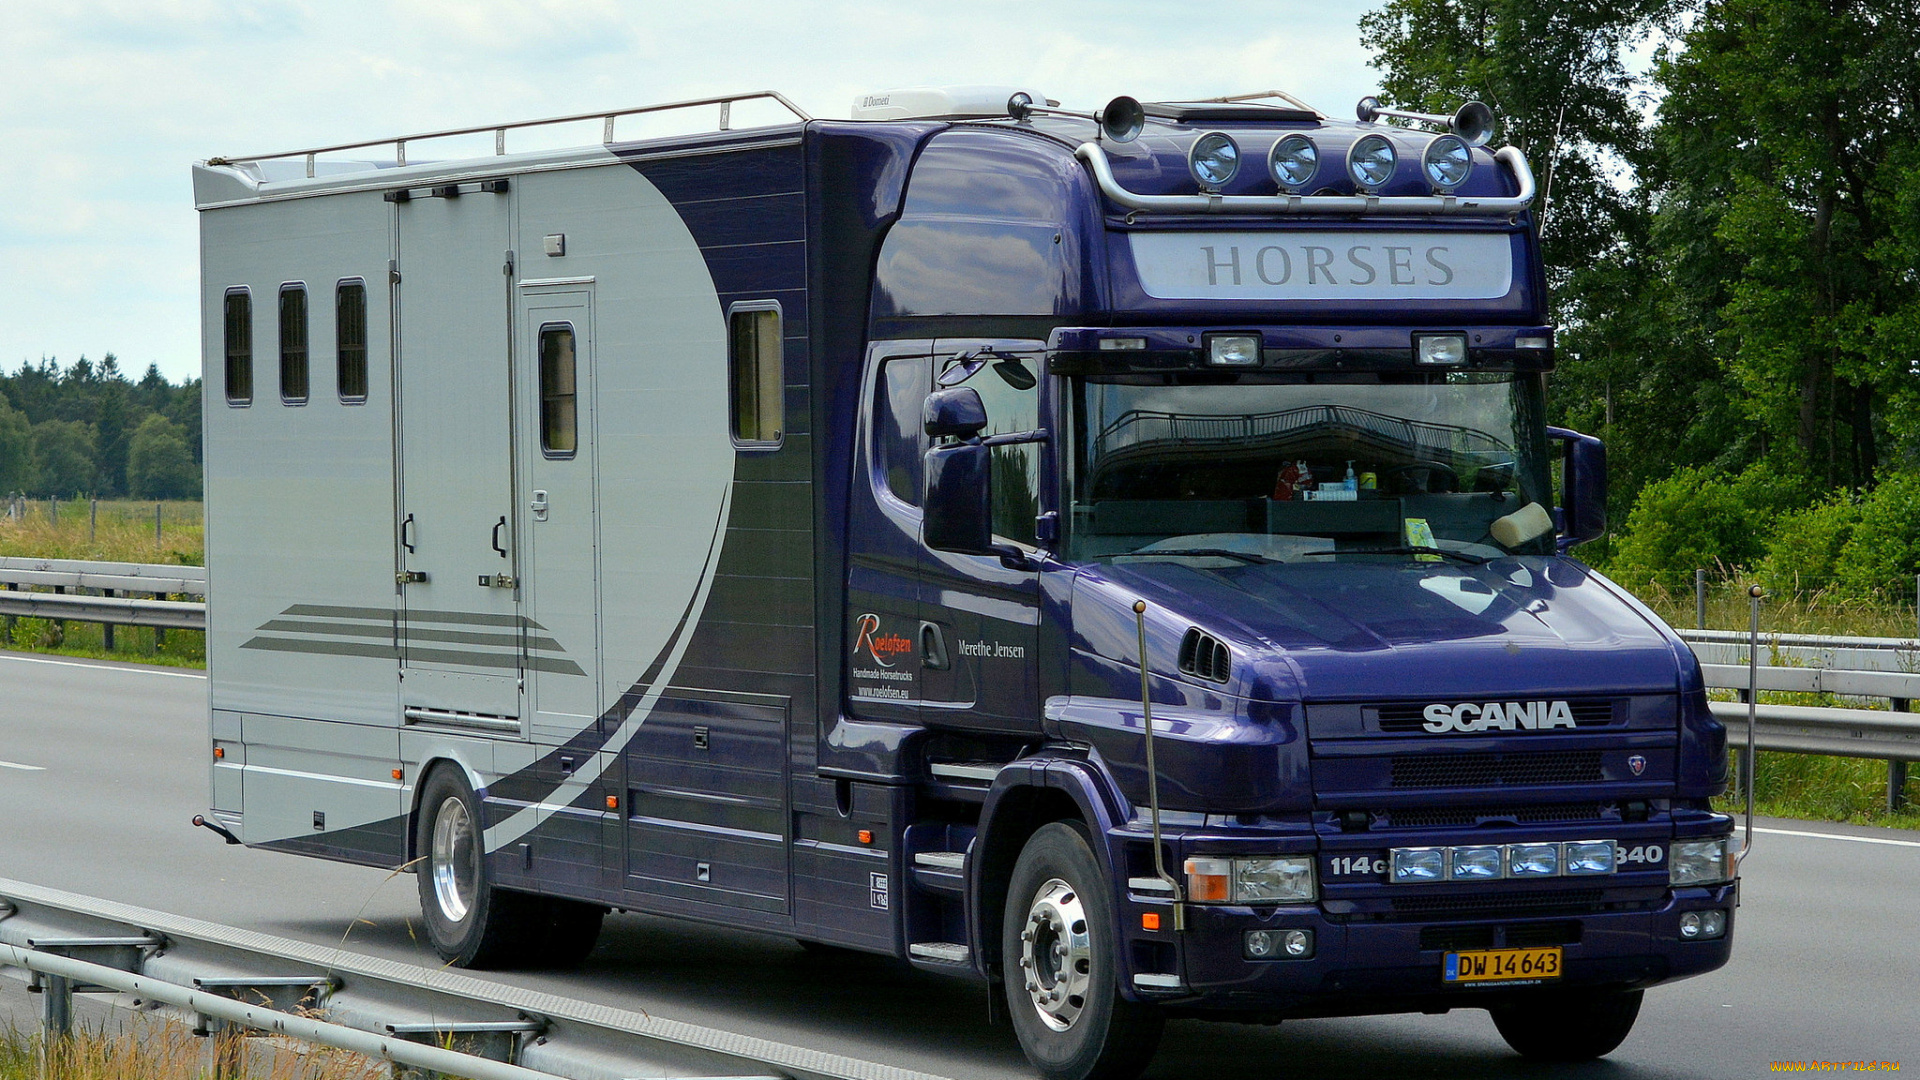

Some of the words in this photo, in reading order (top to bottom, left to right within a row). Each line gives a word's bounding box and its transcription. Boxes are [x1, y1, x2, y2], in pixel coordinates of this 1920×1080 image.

[1200, 245, 1454, 285] HORSES
[853, 613, 911, 667] Roelofsen
[958, 639, 991, 657] Merethe
[993, 641, 1025, 658] Jensen
[853, 667, 879, 679] Handmade
[880, 669, 913, 681] Horsetrucks
[858, 685, 909, 699] www.roelofsen.eu
[1422, 701, 1577, 733] SCANIA
[1459, 955, 1487, 976] DW
[1493, 954, 1516, 975] 14
[1521, 953, 1558, 974] 643
